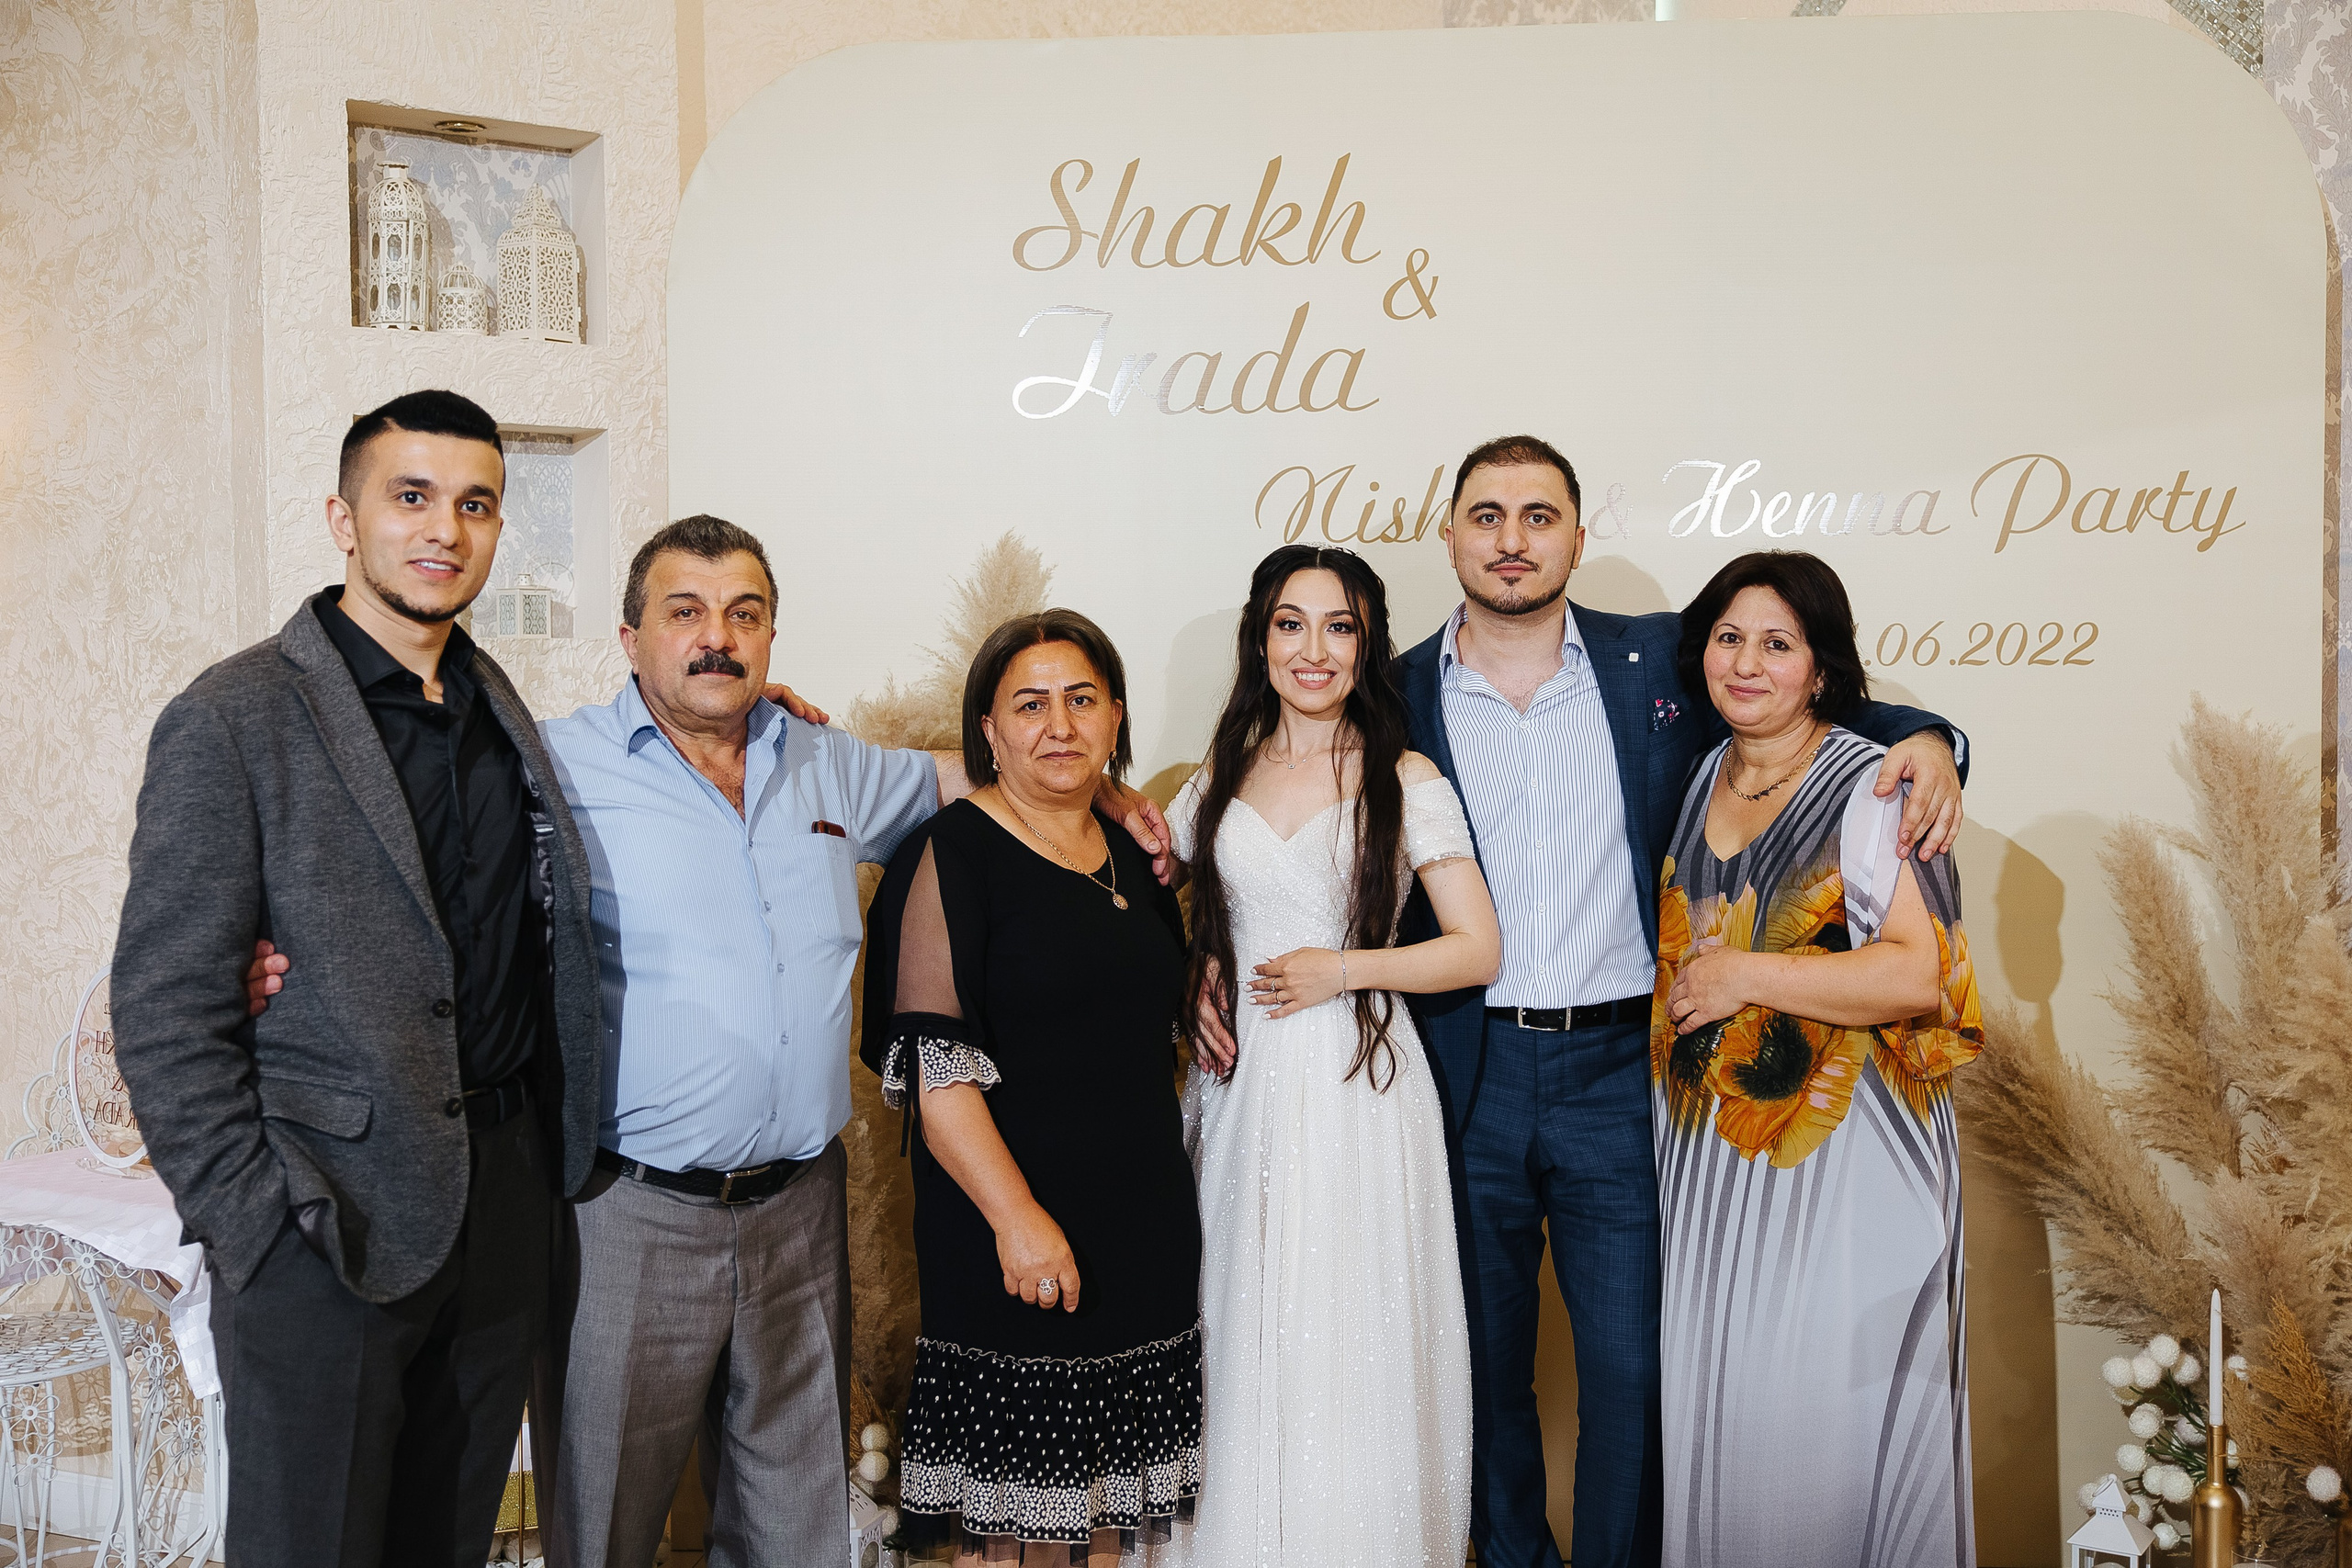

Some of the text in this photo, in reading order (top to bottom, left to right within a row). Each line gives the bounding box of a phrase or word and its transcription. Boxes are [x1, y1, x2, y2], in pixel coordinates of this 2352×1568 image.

[1012, 152, 1382, 272] Shakh
[1382, 247, 1440, 321] &
[1255, 453, 2247, 554] Nish & Henna Party
[1854, 621, 2100, 668] .06.2022
